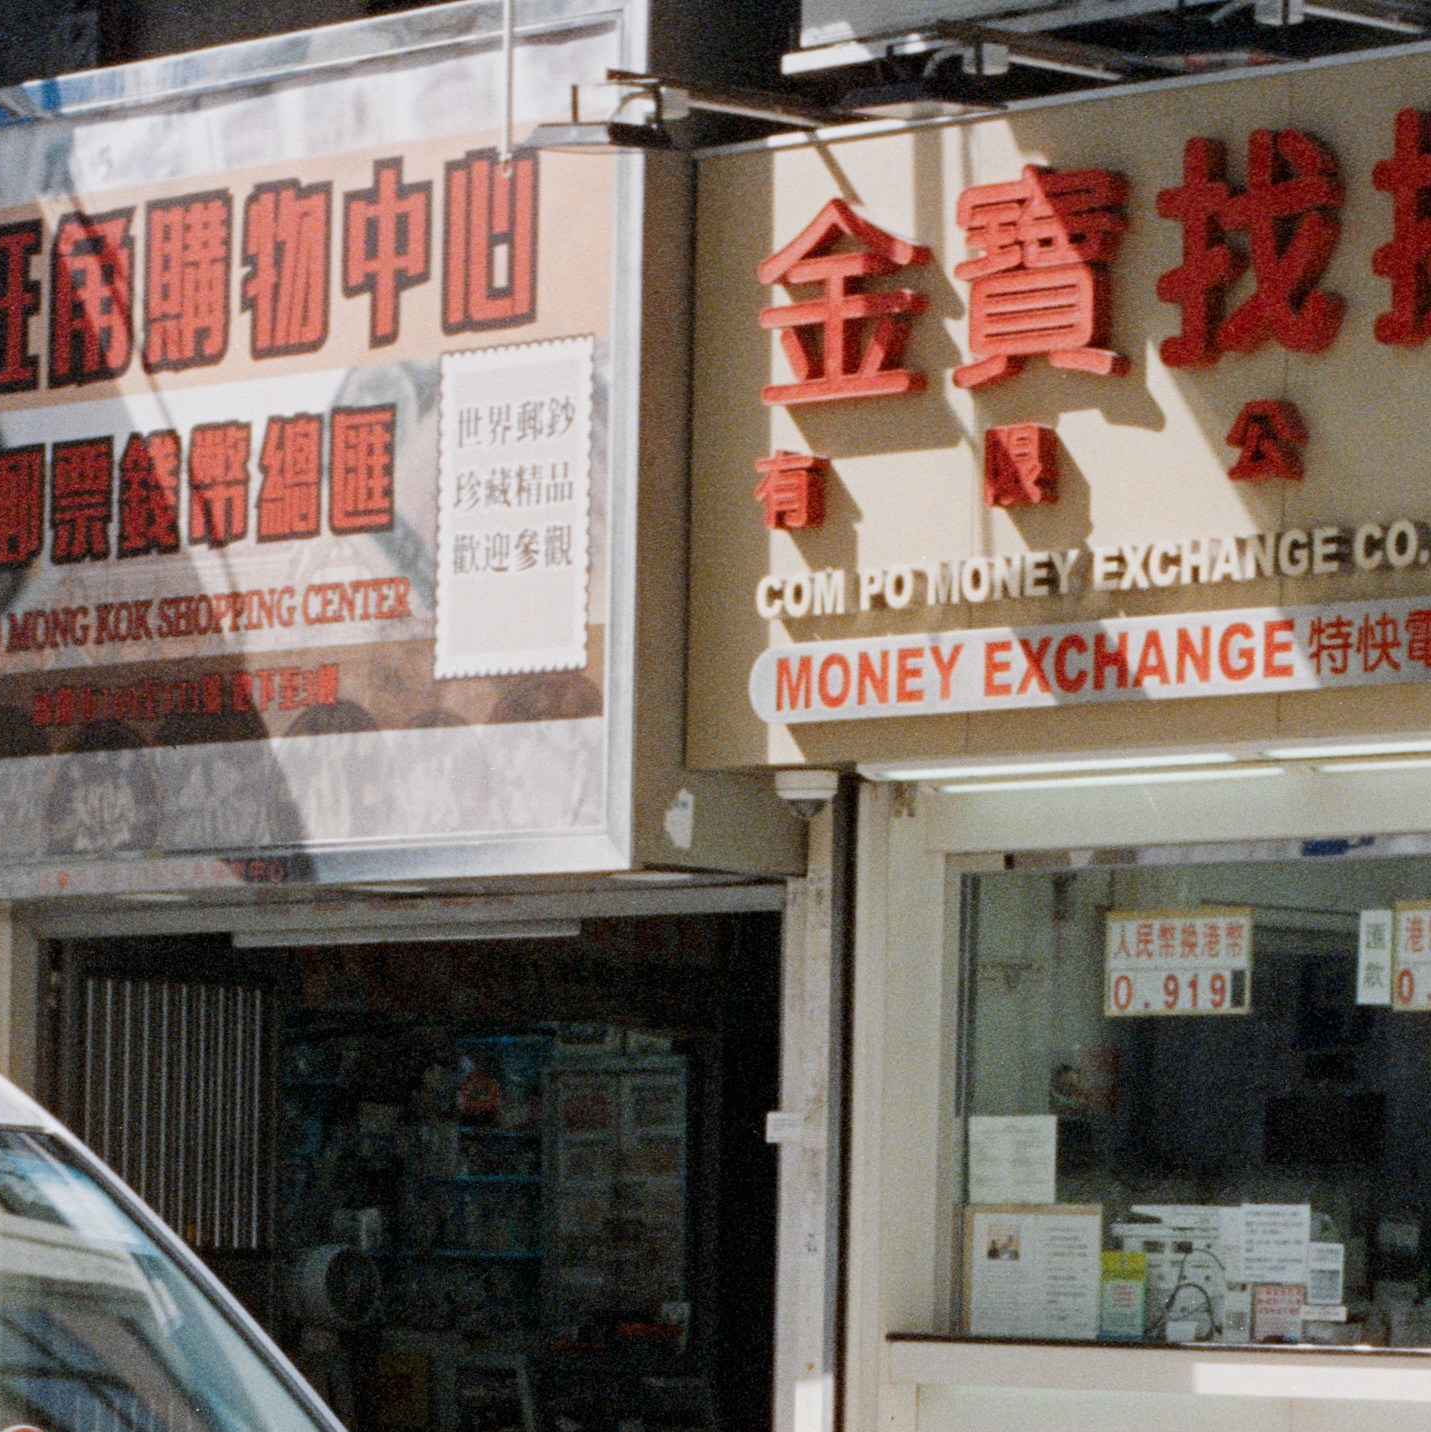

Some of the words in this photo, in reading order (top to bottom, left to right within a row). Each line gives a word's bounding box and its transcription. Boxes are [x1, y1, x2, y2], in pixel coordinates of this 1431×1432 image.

[454, 462, 574, 512] 珍藏精品
[453, 525, 573, 576] 歡迎參觀
[756, 569, 845, 620] COM
[858, 562, 914, 611] PO
[928, 548, 1083, 607] MONEY
[1090, 525, 1343, 591] EXCHANGE
[1353, 523, 1429, 570] CO.
[6, 602, 91, 652] MONG
[93, 598, 155, 645] KOK
[156, 586, 294, 639] SHOPPING
[301, 575, 411, 626] CENTER
[774, 645, 962, 712] MONEY
[983, 618, 1296, 696] EXCHANGE
[1113, 972, 1228, 1011] 0.919
